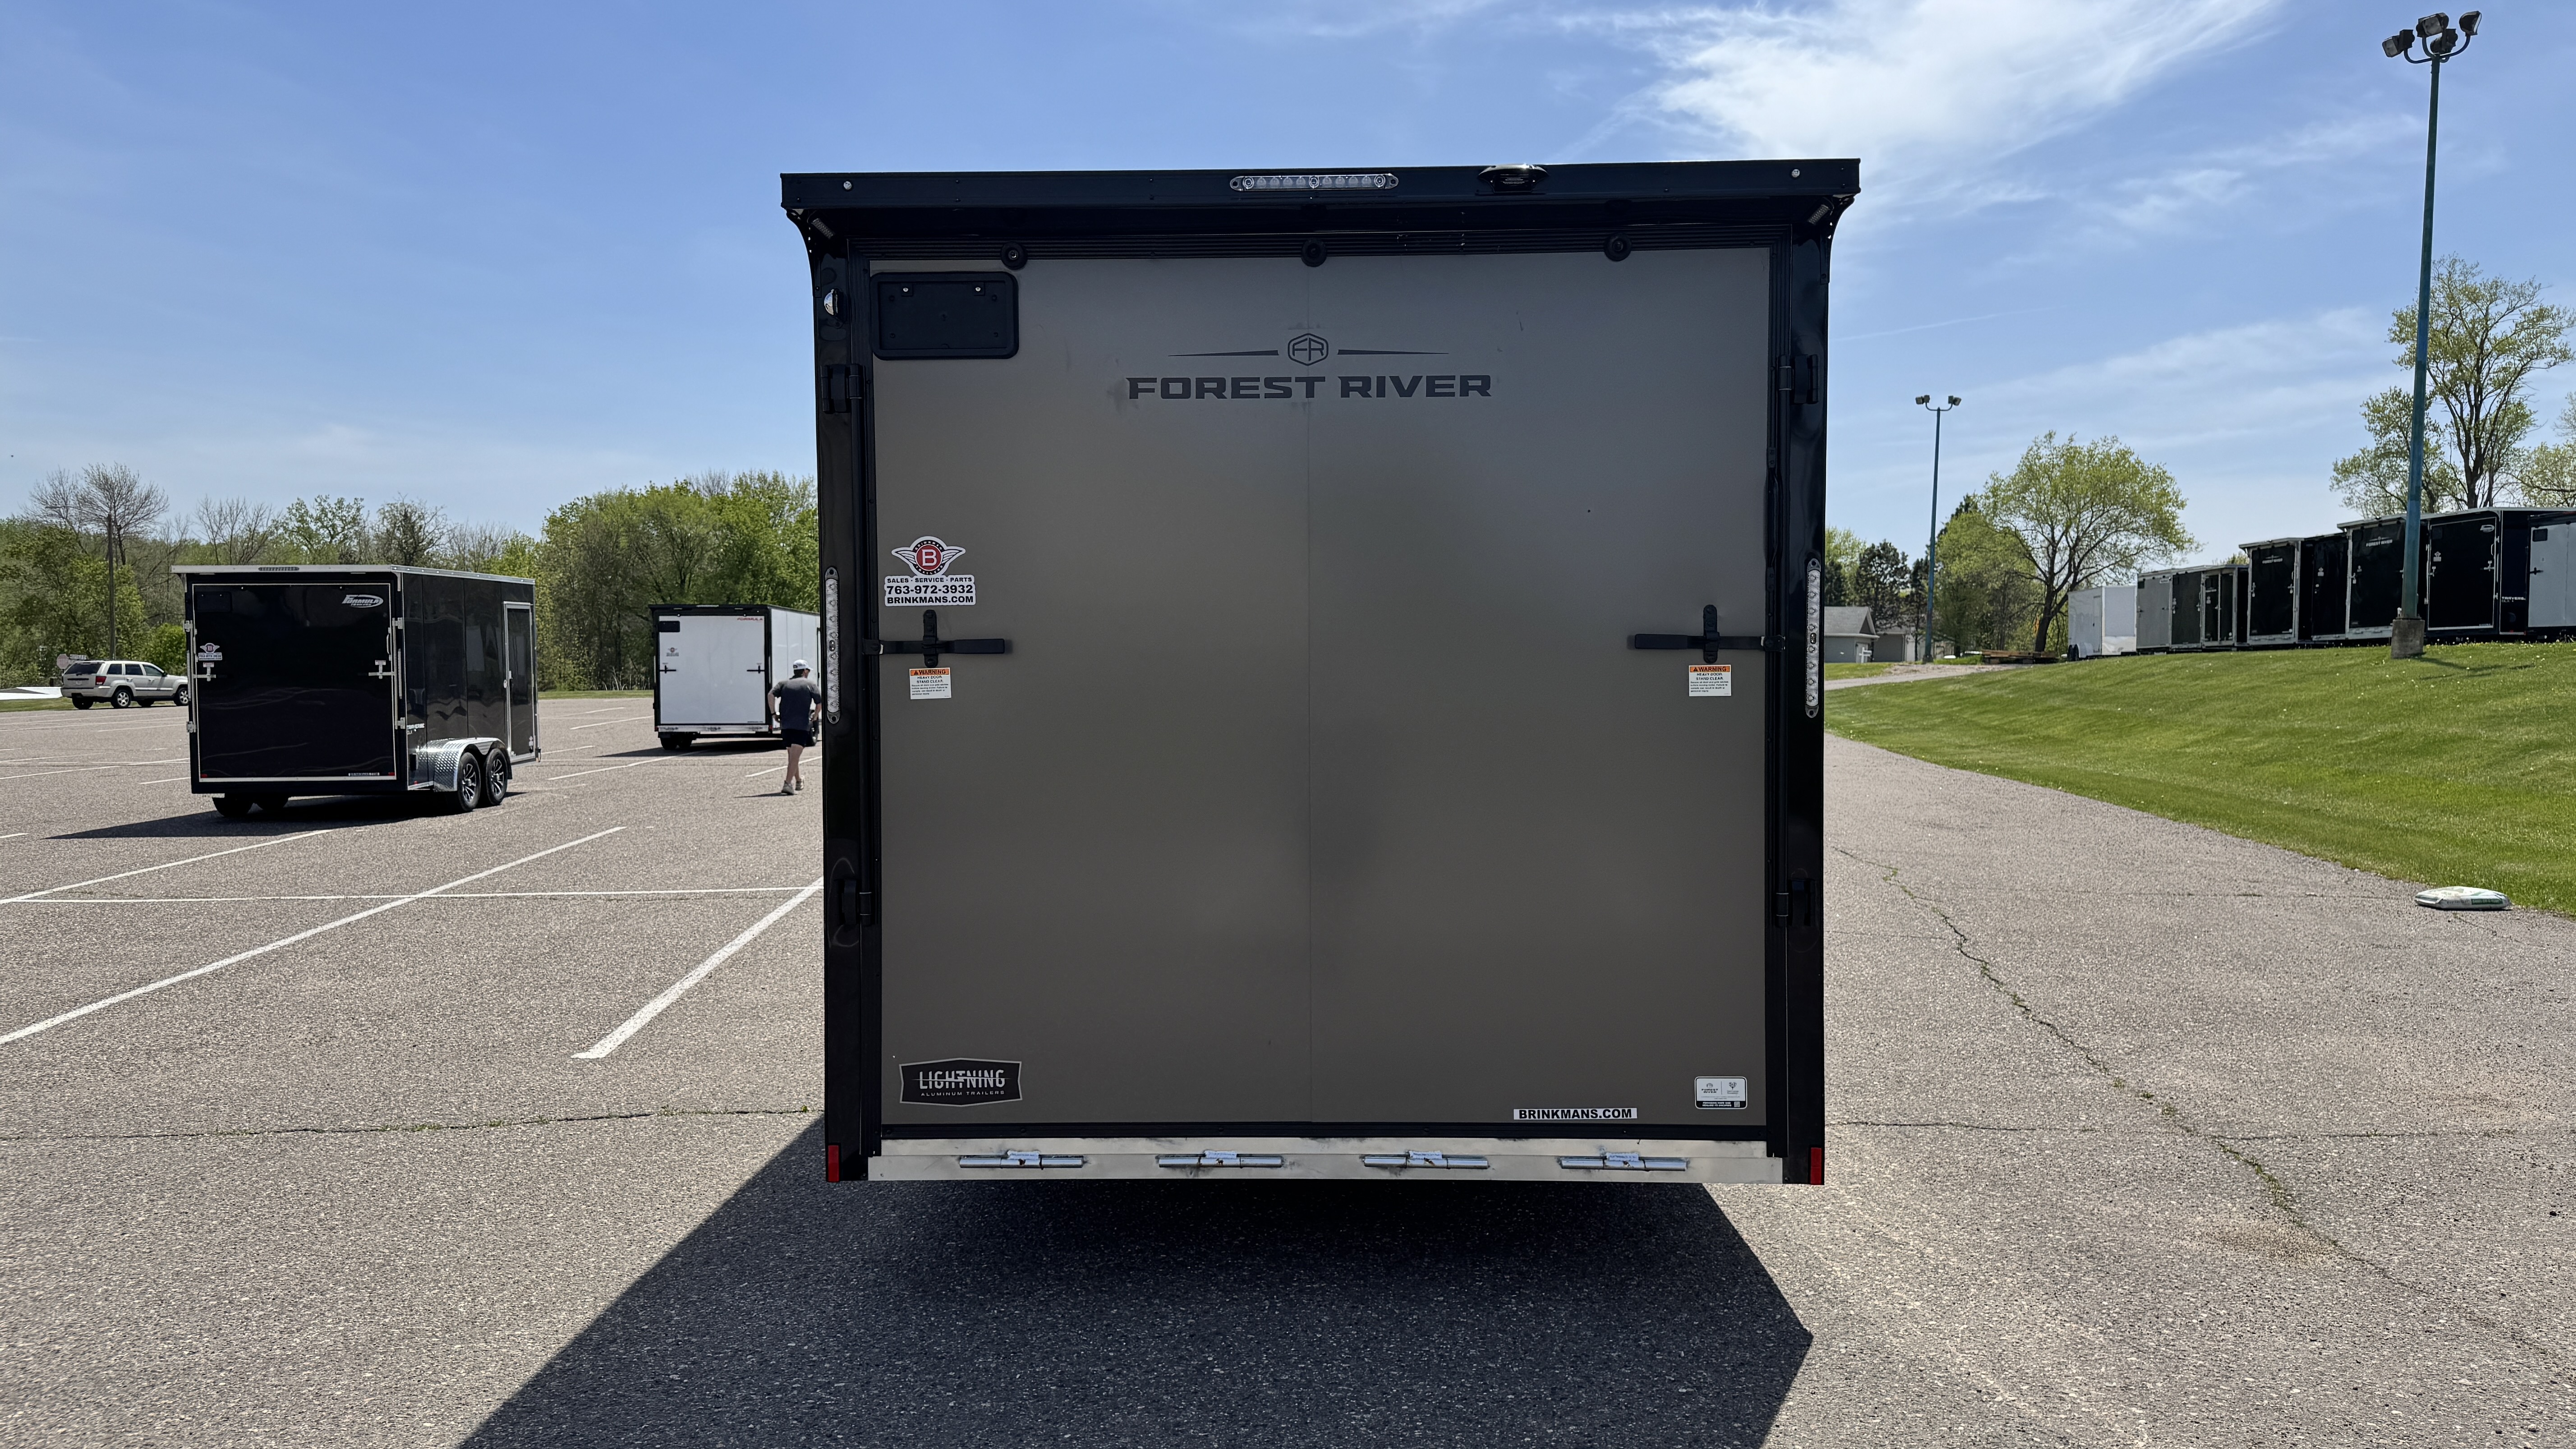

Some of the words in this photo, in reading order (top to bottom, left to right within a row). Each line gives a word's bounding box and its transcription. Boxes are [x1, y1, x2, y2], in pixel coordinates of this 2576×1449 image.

[1126, 377, 1326, 400] FOREST
[1338, 375, 1491, 398] RIVER
[922, 549, 937, 566] B
[887, 584, 973, 594] 763-972-3932
[887, 596, 974, 604] BRINKMANS.COM
[920, 1070, 1005, 1089] LIGHTNING
[1519, 1109, 1632, 1119] BRINKMANS.COM
